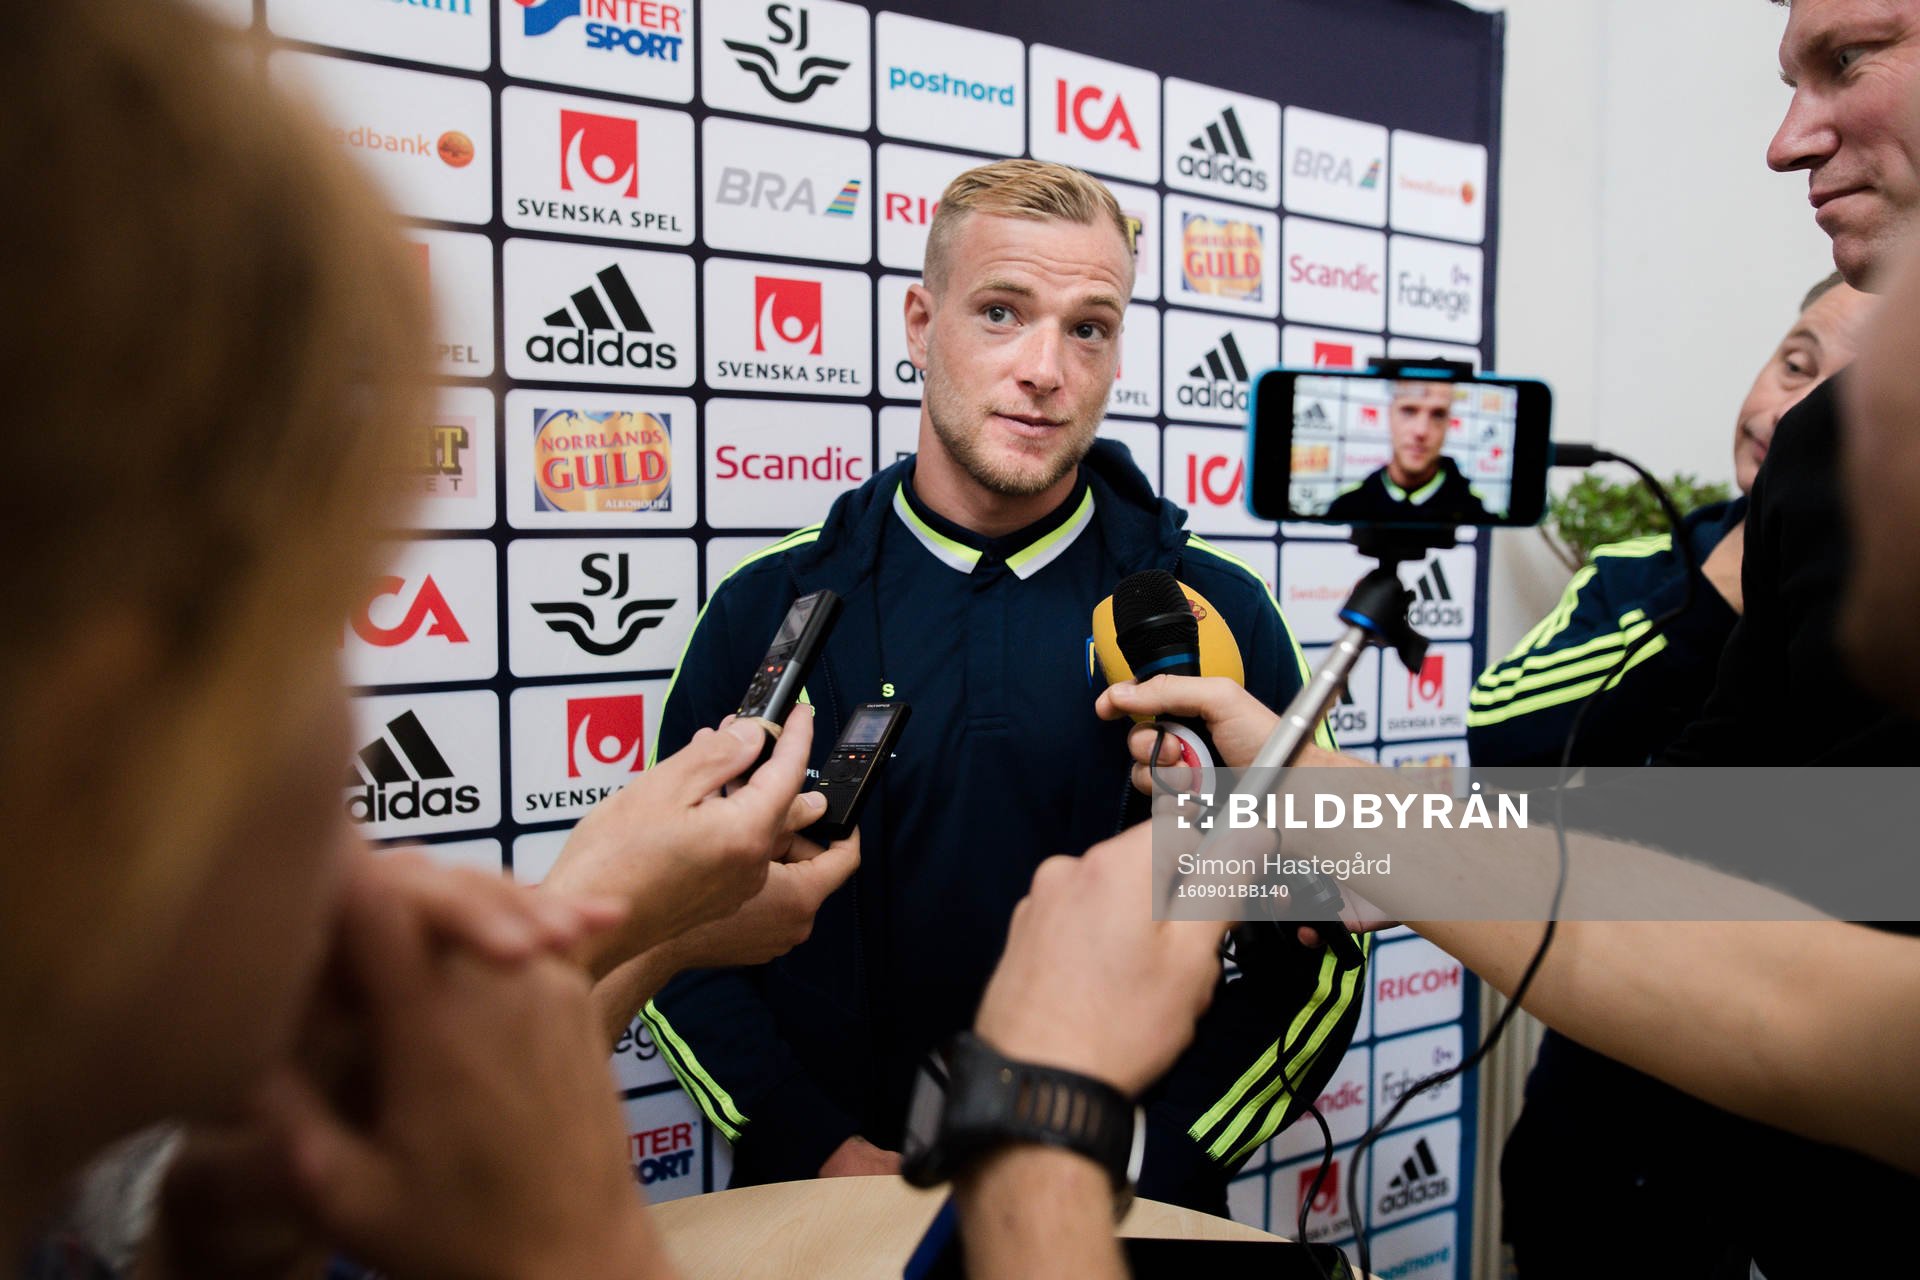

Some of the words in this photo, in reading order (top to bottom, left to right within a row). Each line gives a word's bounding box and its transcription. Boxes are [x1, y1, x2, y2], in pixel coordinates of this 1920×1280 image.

[582, 0, 682, 32] INTER
[766, 3, 809, 51] SJ
[586, 23, 683, 63] SPORT
[889, 65, 1016, 107] postnord
[1056, 78, 1142, 151] ICA
[333, 126, 432, 157] edbank
[1177, 151, 1268, 193] adidas
[1291, 147, 1355, 188] BRA
[715, 166, 817, 211] BRA
[517, 198, 623, 227] SVENSKA
[631, 211, 683, 232] SPEL
[1184, 250, 1262, 280] GULD
[1289, 255, 1380, 295] Scandic
[1399, 270, 1471, 322] Fabege
[525, 328, 678, 371] adidas
[717, 360, 809, 382] SVENSKA
[816, 366, 861, 385] SPEL
[1115, 388, 1150, 407] SPEL
[1177, 378, 1250, 411] adida
[541, 429, 664, 453] NORRLANDS
[541, 449, 668, 493] GULD
[715, 444, 863, 481] Scandic
[580, 552, 630, 600] SJ
[347, 573, 470, 648] CA
[1408, 602, 1463, 627] didas
[882, 683, 896, 698] S
[346, 783, 480, 824] didas
[1378, 965, 1460, 1003] RICOH
[629, 1122, 692, 1158] TER
[633, 1149, 696, 1185] ORT
[1377, 1176, 1449, 1215] adidas
